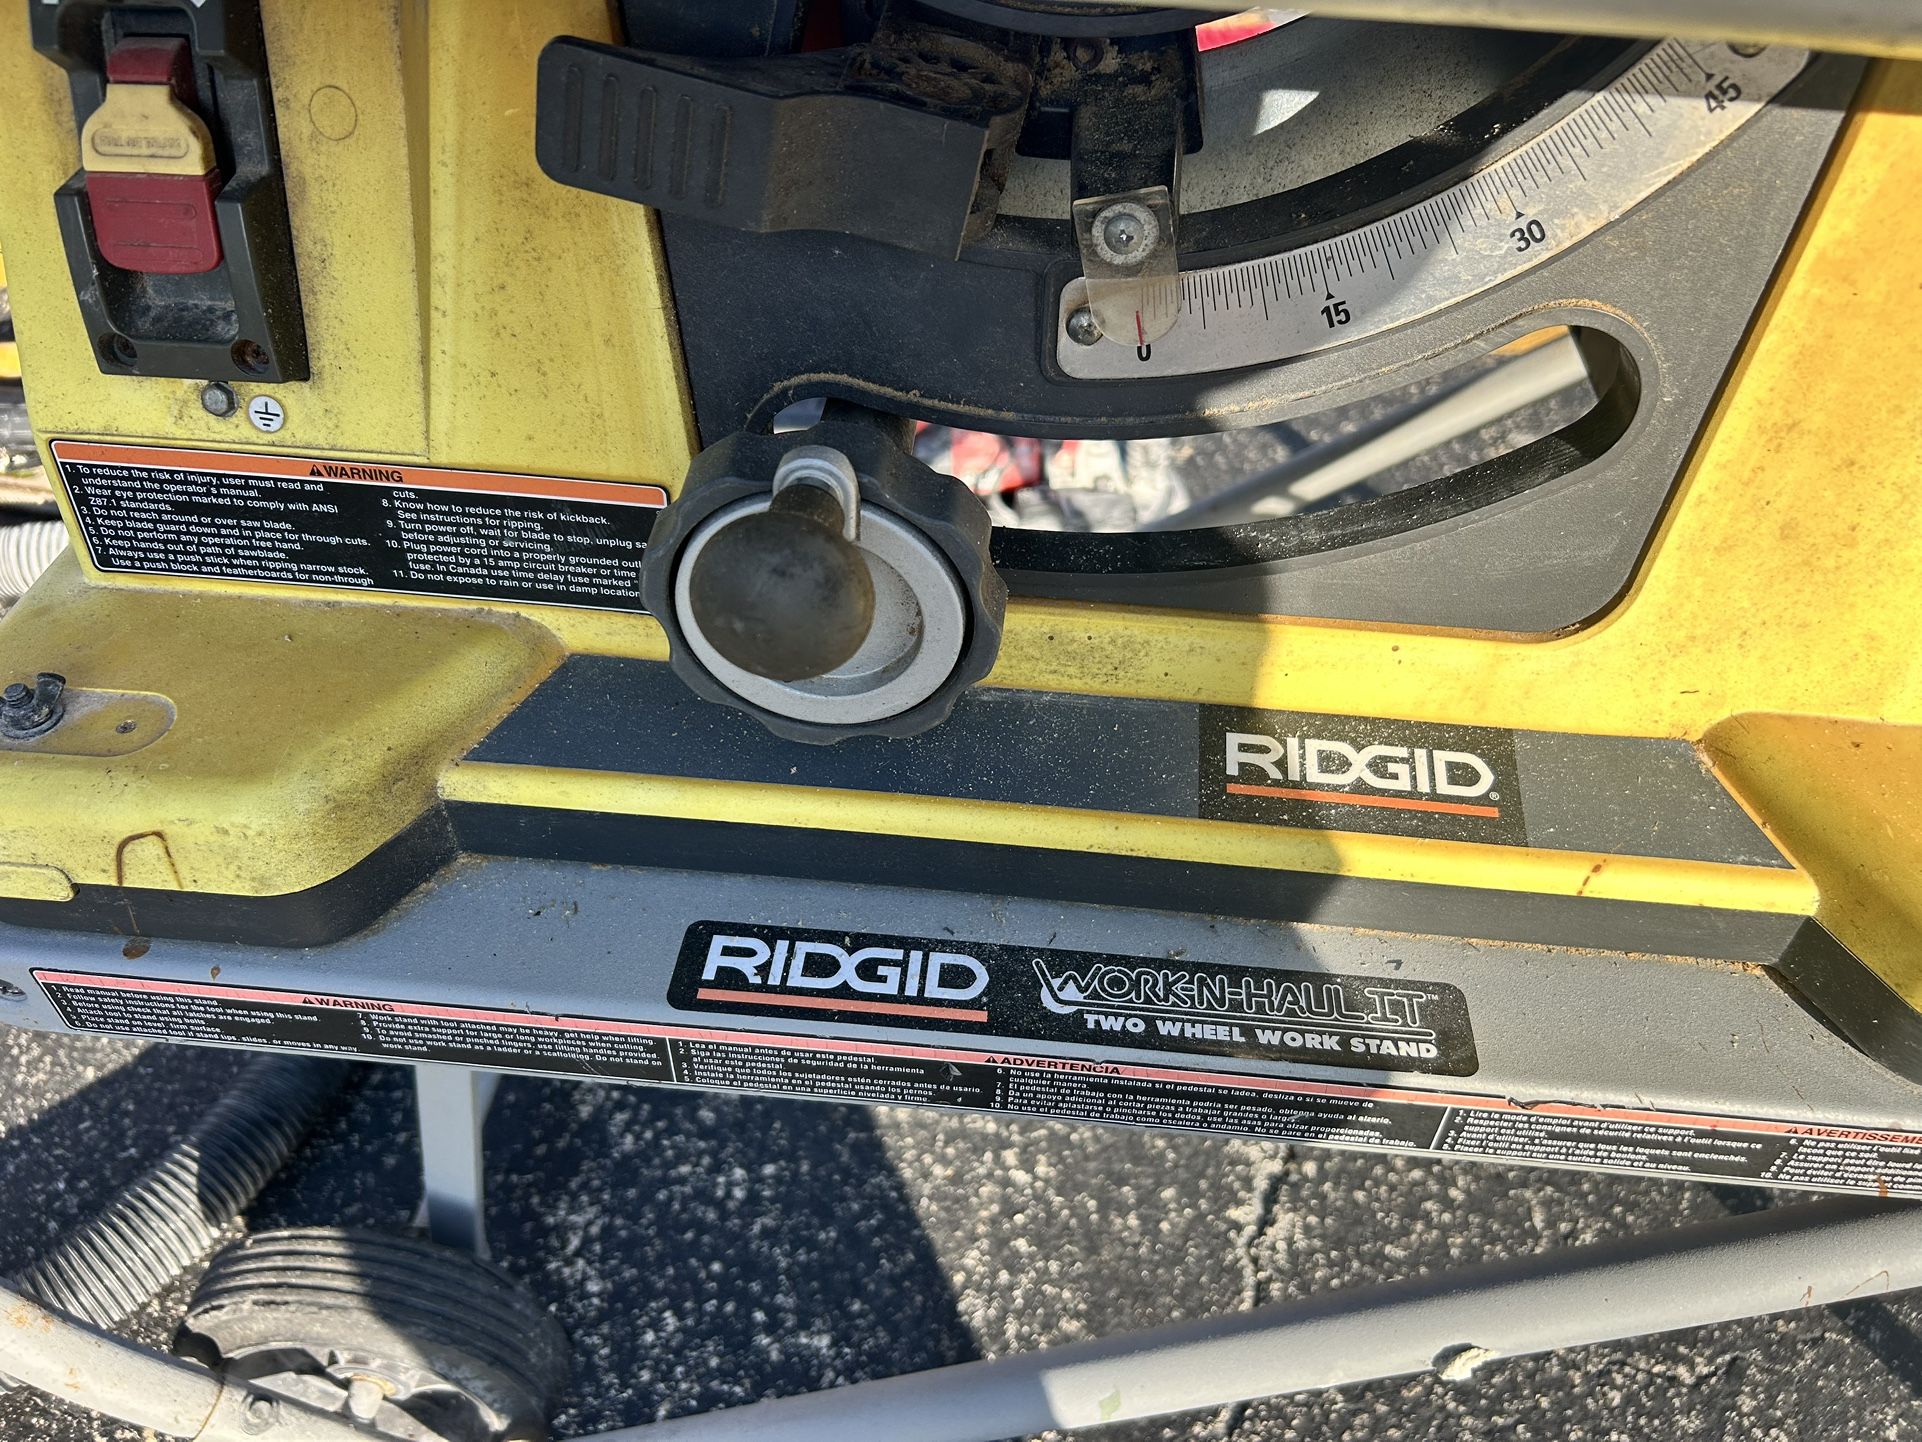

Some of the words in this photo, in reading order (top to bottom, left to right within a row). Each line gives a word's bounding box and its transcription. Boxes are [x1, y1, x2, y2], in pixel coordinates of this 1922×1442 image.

[1704, 75, 1742, 114] 45
[1509, 219, 1546, 252] 30
[1320, 301, 1351, 328] 15
[65, 464, 75, 473] 1.
[78, 465, 90, 474] To
[92, 466, 129, 477] reduce
[131, 469, 148, 478] the
[151, 470, 172, 480] risk
[174, 472, 184, 481] of
[187, 473, 220, 486] injury,
[222, 478, 245, 486] user
[248, 479, 275, 488] must
[277, 481, 301, 490] read
[304, 483, 324, 492] and
[82, 476, 141, 488] understand
[143, 480, 160, 490] the
[163, 484, 218, 494] operator's
[220, 488, 261, 497] manual.
[323, 465, 403, 482] WARNING
[73, 485, 83, 494] 2.
[85, 486, 112, 496] Wear
[115, 490, 134, 499] eye
[136, 491, 190, 502] protection
[192, 495, 231, 505] marked
[233, 497, 244, 506] to
[247, 500, 284, 511] comply
[287, 502, 309, 511] with
[312, 503, 338, 513] ANSI
[90, 496, 117, 507] Z87.1
[120, 499, 175, 511] standards.
[393, 489, 418, 499] cuts.
[80, 505, 90, 514] 3.
[92, 506, 108, 515] Do
[110, 508, 128, 517] not
[130, 510, 159, 519] reach
[161, 513, 199, 522] around
[214, 517, 237, 525] over
[240, 519, 261, 527] saw
[263, 519, 295, 530] blade.
[382, 498, 392, 507] 8.
[394, 499, 424, 510] Know
[426, 502, 449, 512] how
[452, 504, 463, 513] to
[465, 506, 502, 516] reduce
[504, 508, 521, 518] the
[524, 510, 544, 520] risk
[546, 512, 557, 521] of
[560, 513, 610, 525] kickback.
[397, 510, 417, 520] See
[420, 511, 483, 525] instructions
[485, 517, 500, 526] for
[503, 518, 544, 531] ripping.
[85, 516, 95, 525] 4.
[96, 516, 124, 529] Keep
[125, 519, 154, 529] blade
[156, 523, 187, 532] guard
[189, 524, 218, 534] down
[220, 527, 240, 536] and
[242, 528, 252, 537] in
[254, 529, 282, 540] place
[284, 531, 299, 540] for
[301, 532, 343, 545] through
[345, 537, 371, 546] cuts.
[88, 526, 98, 535] 5.
[100, 526, 116, 536] Do
[118, 529, 135, 537] not
[137, 530, 178, 541] perform
[180, 534, 198, 544] any
[201, 536, 250, 546] operation
[252, 538, 272, 548] free
[274, 540, 304, 550] hand.
[386, 519, 396, 528] 9.
[399, 520, 422, 530] Turn
[424, 524, 457, 533] power
[460, 525, 477, 537] off,
[479, 528, 501, 537] wait
[504, 528, 518, 538] for
[521, 530, 551, 541] blade
[553, 533, 564, 542] to
[567, 534, 593, 546] stop,
[596, 538, 632, 549] unplug
[401, 530, 435, 541] before
[438, 534, 486, 547] adjusting
[502, 540, 553, 553] servicing.
[92, 536, 102, 545] 6.
[104, 537, 131, 549] Keep
[132, 539, 165, 550] hands
[167, 542, 184, 551] out
[186, 543, 197, 552] of
[199, 545, 223, 555] path
[224, 546, 235, 555] of
[238, 548, 289, 559] sawblade.
[96, 545, 106, 554] 7.
[109, 546, 145, 559] Always
[146, 551, 166, 559] use
[177, 553, 203, 563] push
[205, 554, 230, 564] stick
[231, 557, 259, 566] when
[261, 559, 298, 571] ripping
[300, 563, 335, 572] narrow
[338, 565, 368, 575] stock.
[112, 557, 132, 566] Use
[143, 560, 169, 570] push
[170, 561, 199, 572] block
[201, 564, 220, 573] and
[222, 565, 293, 579] featherboards
[295, 571, 309, 580] for
[312, 574, 374, 587] non-through
[1226, 732, 1495, 798] RIDGID
[701, 935, 990, 1000] RIDGID
[316, 997, 394, 1012] WARNING
[1083, 1013, 1146, 1033] TWO
[1155, 1019, 1246, 1042] WHEEL
[1254, 1028, 1343, 1051] WORK
[1349, 1037, 1438, 1059] STAND
[1001, 1056, 1121, 1075] ADVERTENCIA
